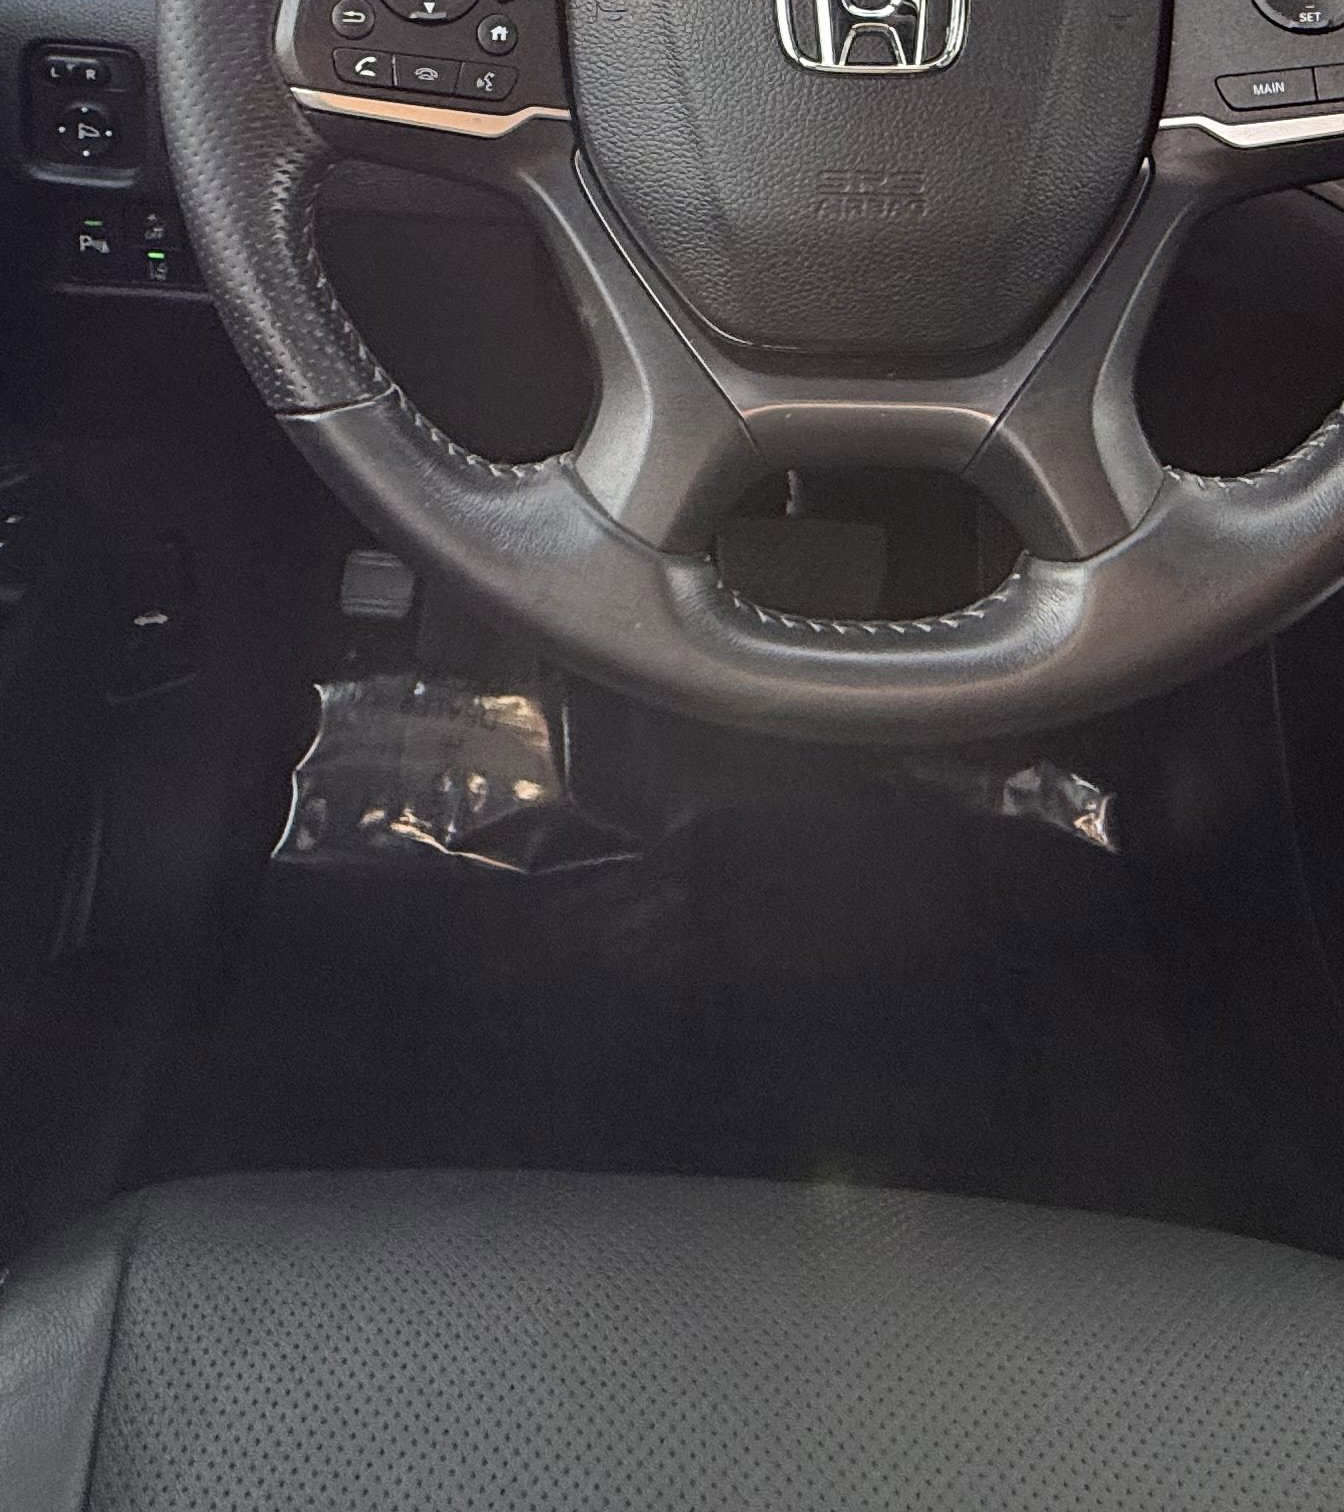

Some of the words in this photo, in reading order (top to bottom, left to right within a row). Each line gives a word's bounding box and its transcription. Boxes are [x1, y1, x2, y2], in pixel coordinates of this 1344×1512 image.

[1298, 12, 1322, 23] SET
[50, 67, 60, 79] L
[85, 68, 97, 80] R
[1253, 82, 1286, 95] MAIN
